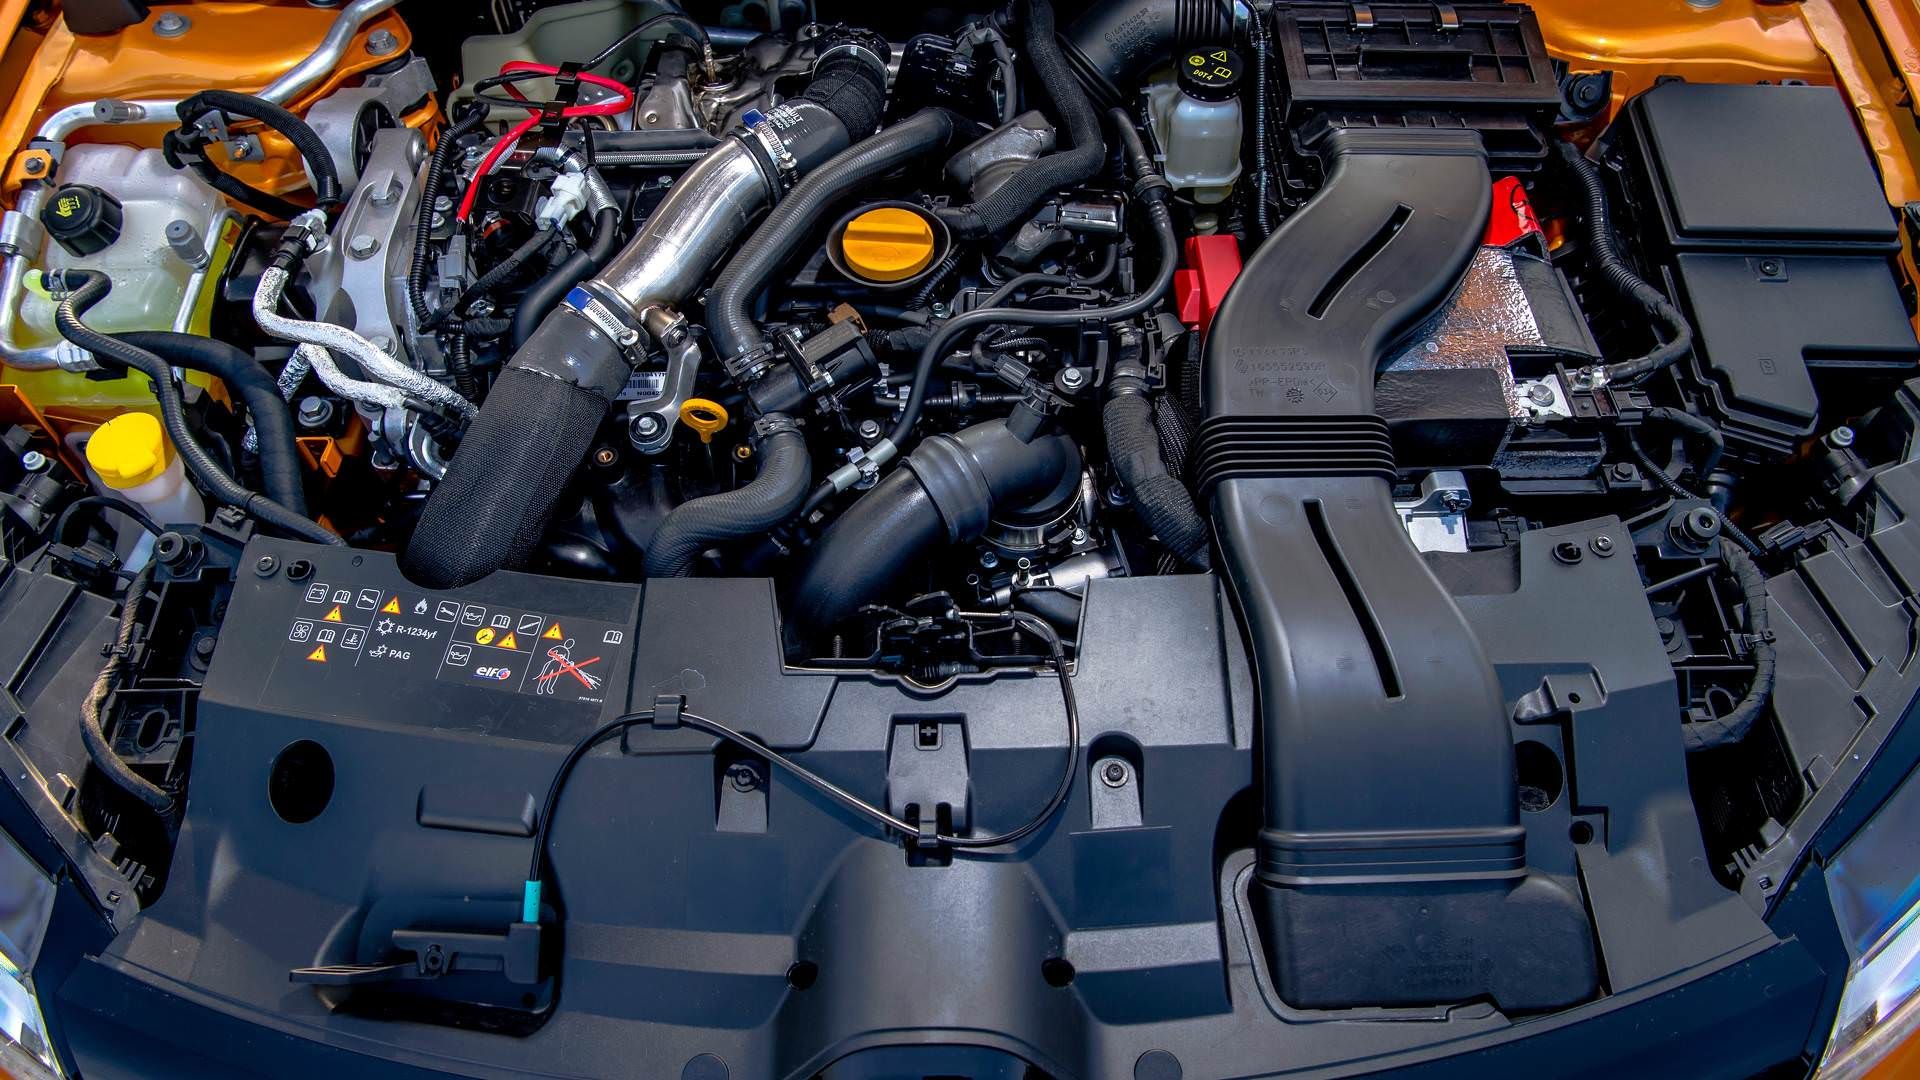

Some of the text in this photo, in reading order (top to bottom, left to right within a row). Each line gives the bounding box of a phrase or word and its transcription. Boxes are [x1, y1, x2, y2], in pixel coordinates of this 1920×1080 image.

[1193, 69, 1213, 81] DOT4
[396, 625, 437, 640] R-1234yf
[389, 649, 411, 660] PAG
